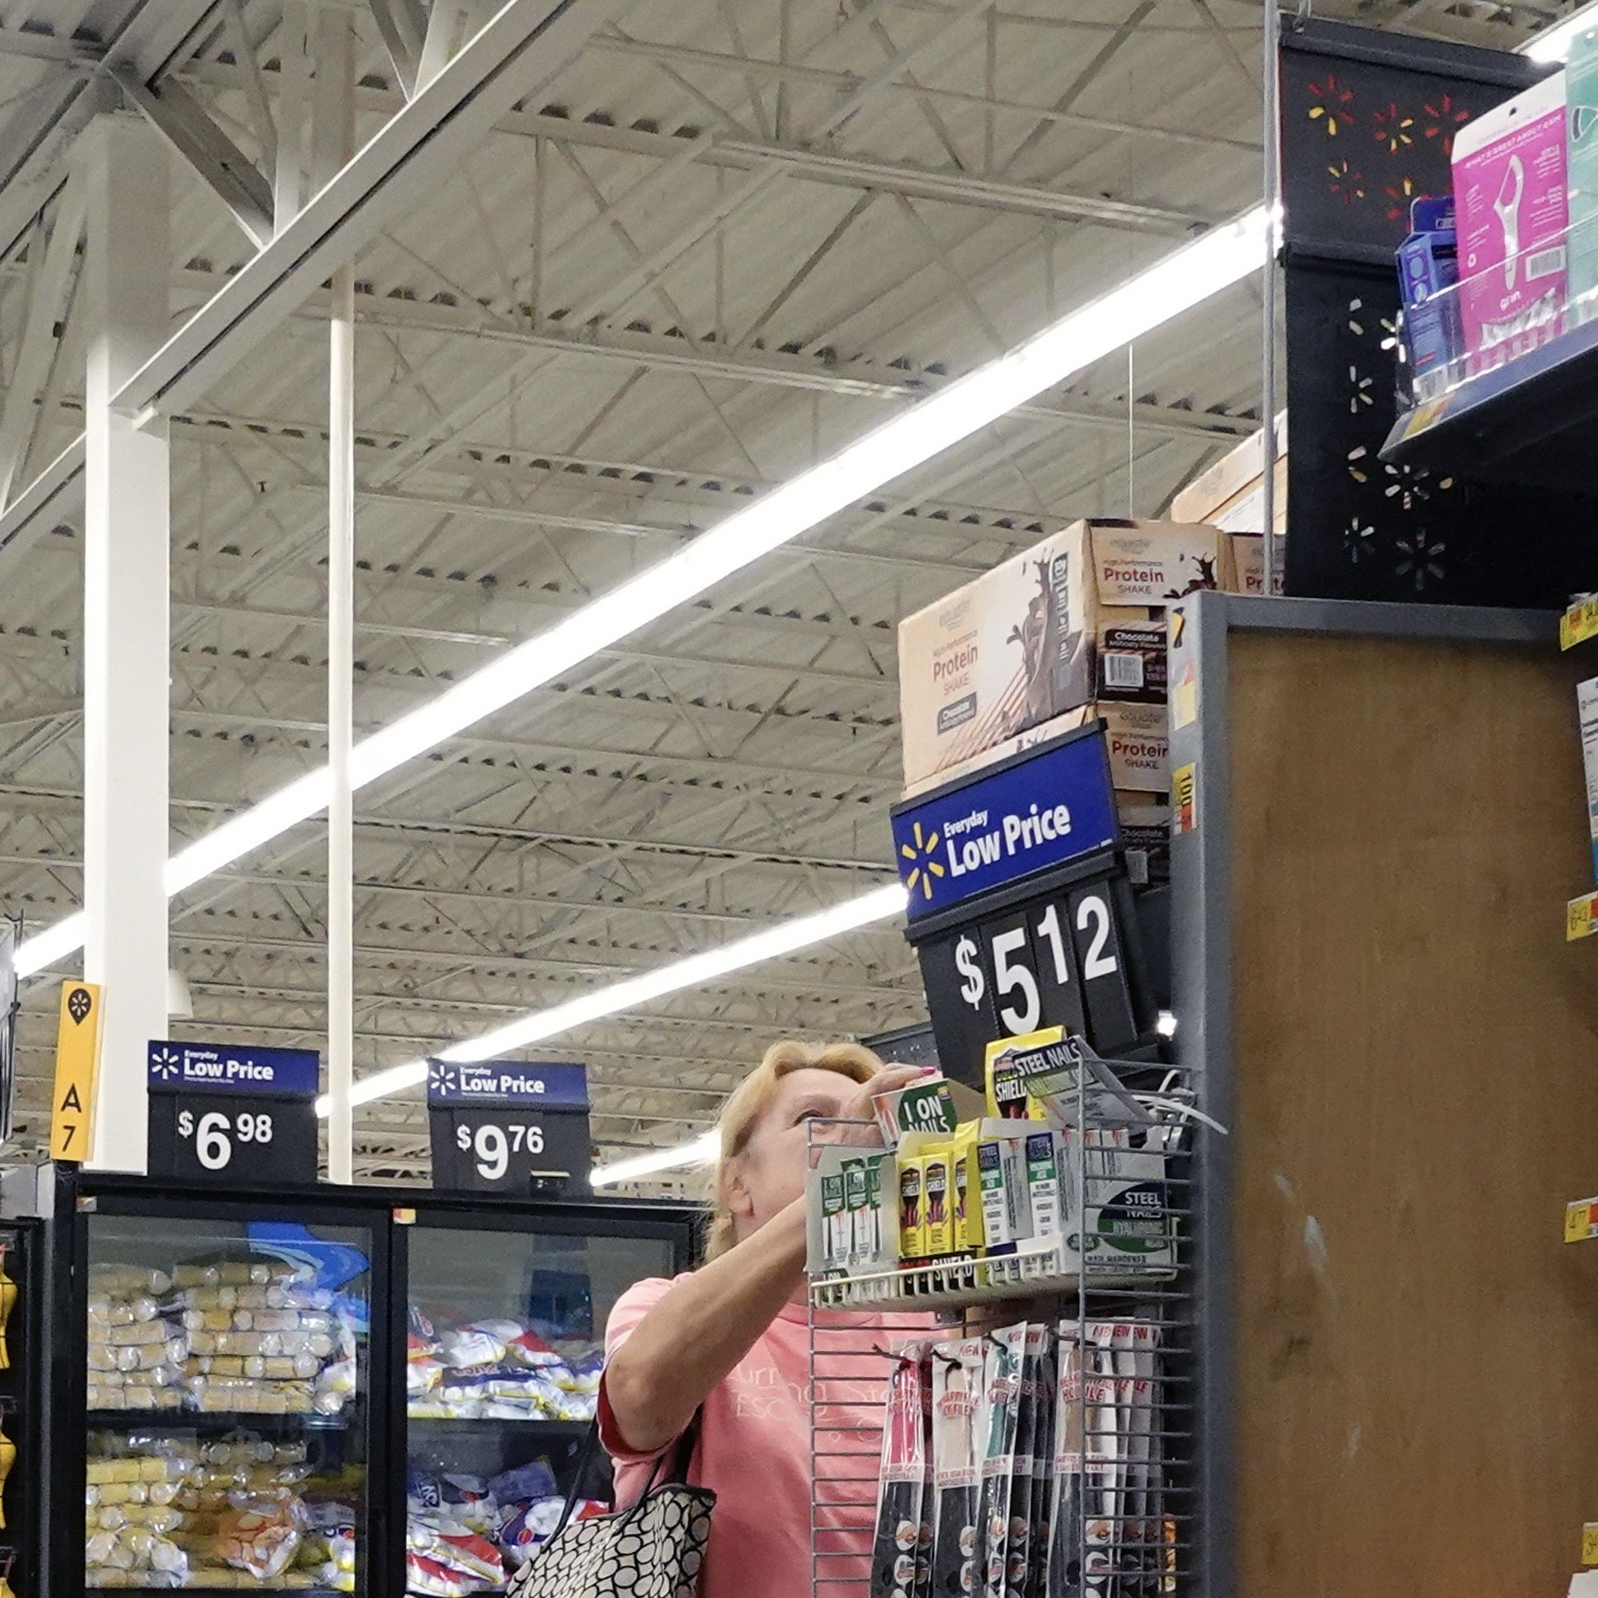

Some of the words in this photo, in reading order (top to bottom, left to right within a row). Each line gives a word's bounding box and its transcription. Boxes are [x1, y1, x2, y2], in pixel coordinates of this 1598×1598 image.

[1104, 567, 1164, 583] Protein
[1117, 584, 1152, 595] SHAKE
[933, 647, 979, 683] Protein
[1125, 758, 1159, 770] SHAKE
[943, 809, 989, 838] Everyday
[947, 829, 1001, 878] Low
[1003, 802, 1071, 857] Price
[184, 1049, 219, 1061] Everyday
[1015, 1053, 1050, 1078] STEEL
[1050, 1042, 1082, 1068] NAILS
[183, 1059, 224, 1079] Low
[227, 1060, 274, 1081] Price
[460, 1075, 498, 1093] Low
[499, 1076, 545, 1095] Price
[996, 1080, 1028, 1102] SHIELD
[60, 1085, 82, 1113] A
[918, 1096, 943, 1119] ON
[62, 1125, 75, 1152] 7
[1125, 1191, 1162, 1206] STEEL
